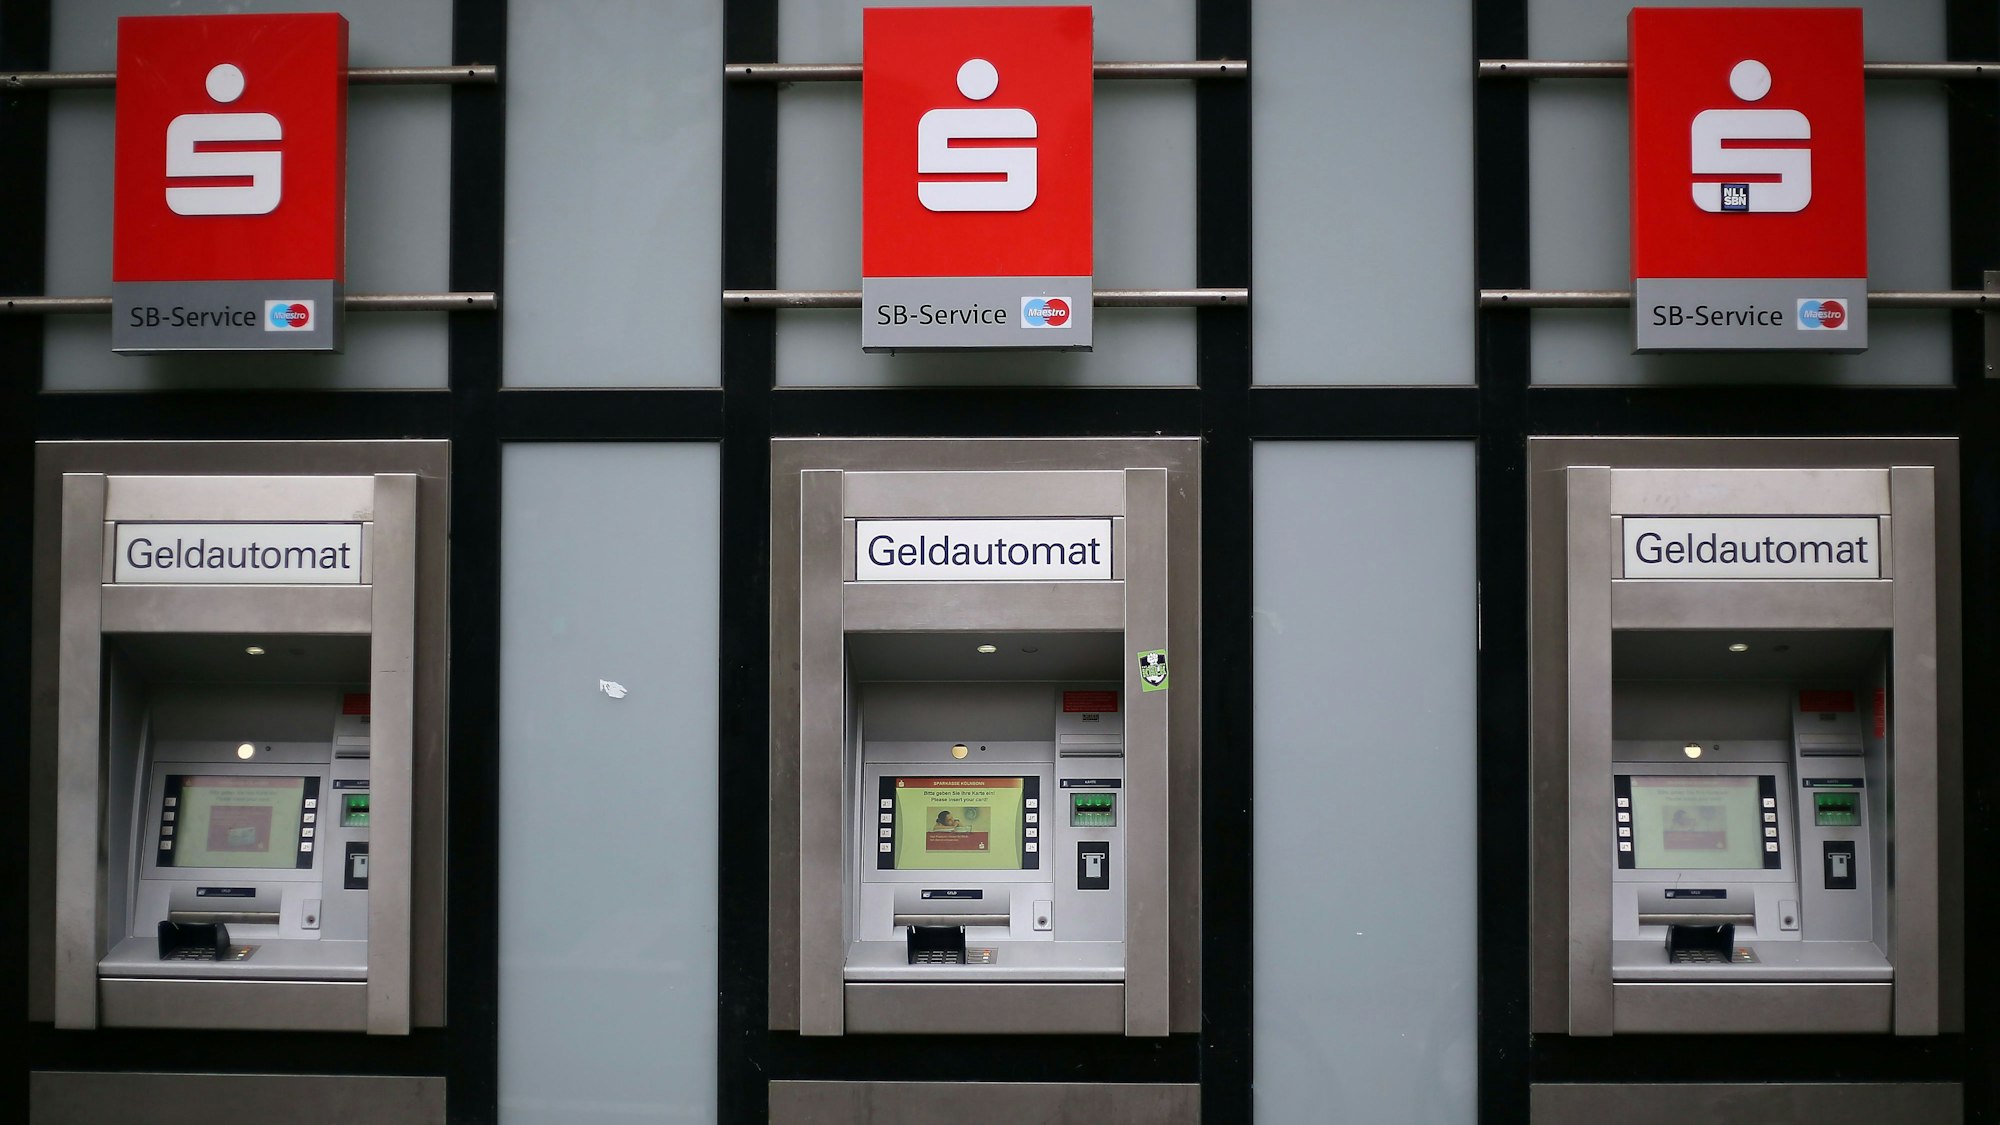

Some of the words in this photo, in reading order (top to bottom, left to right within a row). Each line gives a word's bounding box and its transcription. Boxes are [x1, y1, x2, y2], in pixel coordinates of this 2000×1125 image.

[1723, 187, 1747, 197] NLL
[1723, 196, 1747, 206] SBN
[130, 305, 257, 328] SB-Service
[273, 310, 306, 321] Maestro
[877, 303, 1007, 326] SB-Service
[1027, 307, 1066, 318] Maestro
[1652, 305, 1783, 327] SB-Service
[1803, 309, 1842, 320] Maestro
[126, 537, 352, 569] Geldautomat
[867, 534, 1101, 566] Geldautomat
[1635, 531, 1869, 564] Geldautomat
